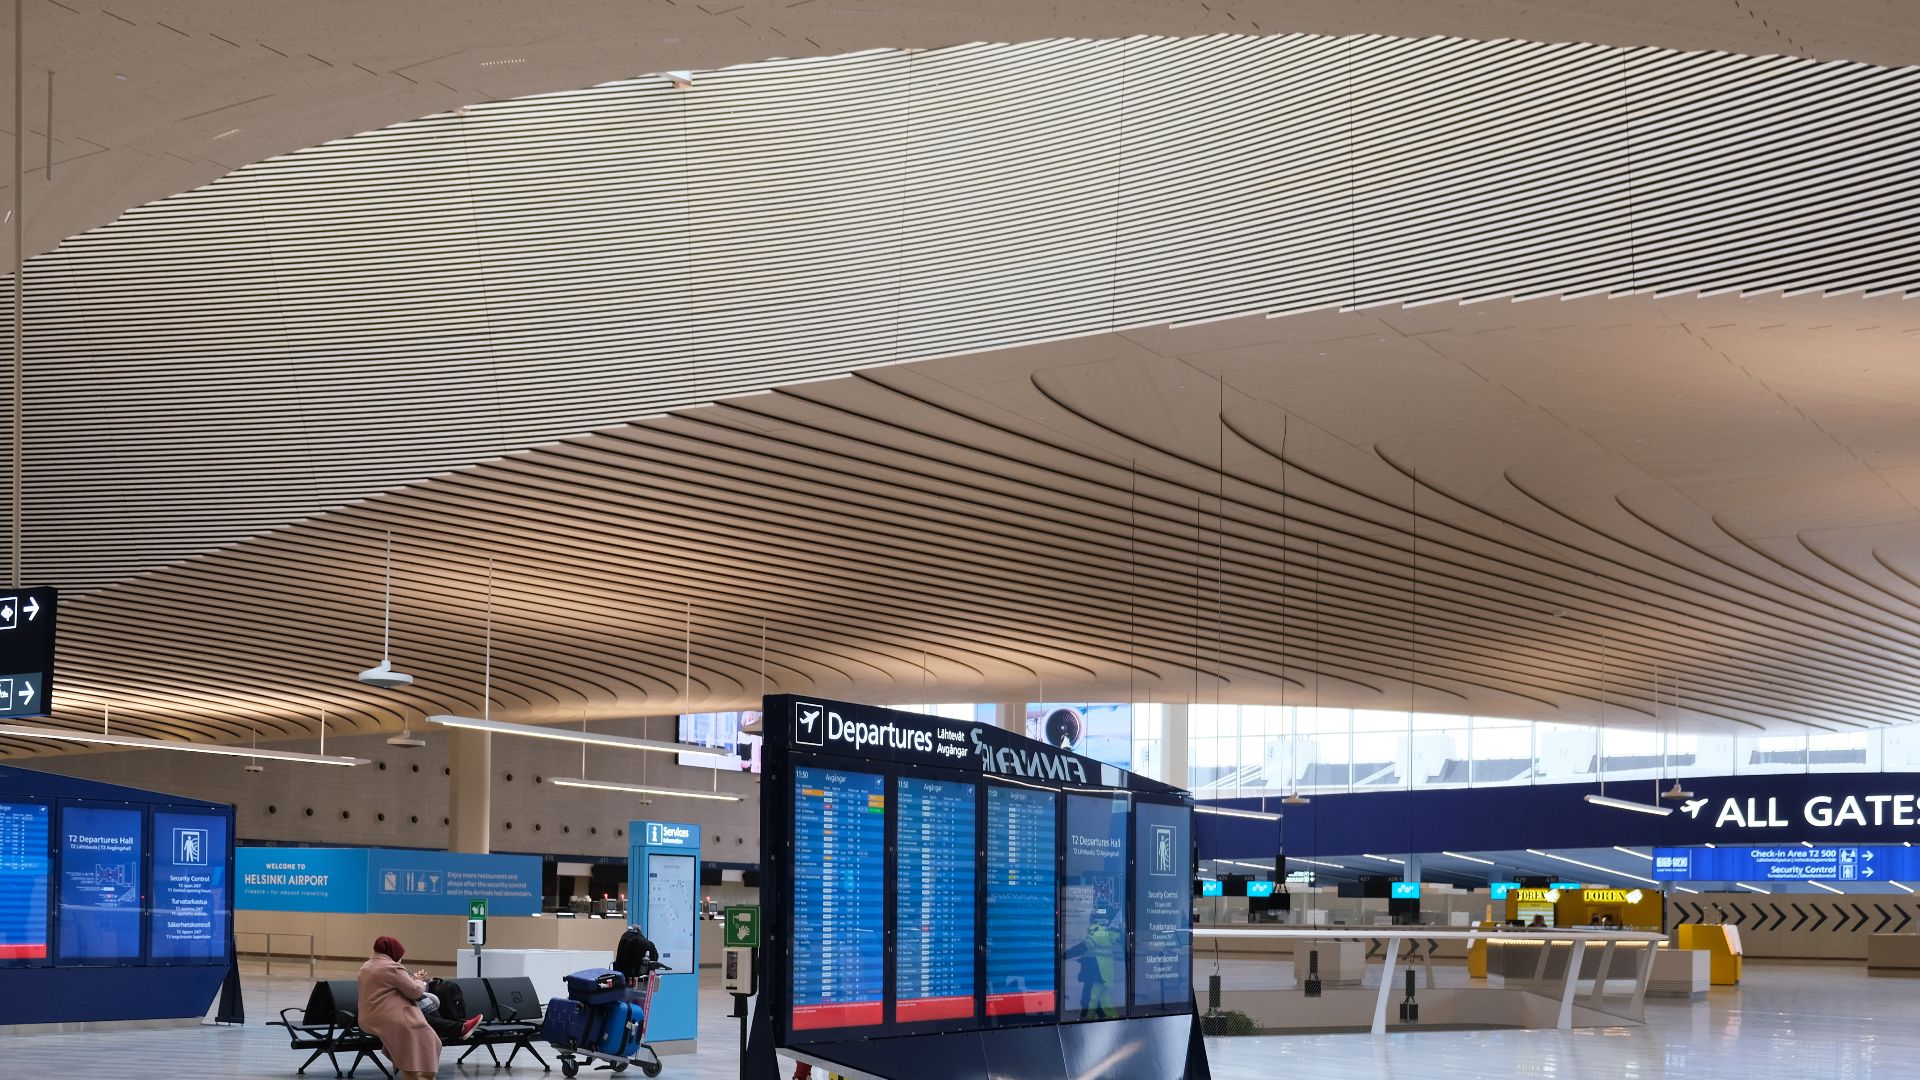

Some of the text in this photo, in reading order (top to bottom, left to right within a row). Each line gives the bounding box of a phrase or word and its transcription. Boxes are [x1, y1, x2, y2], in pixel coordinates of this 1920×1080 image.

[828, 711, 932, 751] Departures
[937, 727, 965, 742] Lähtevät
[937, 743, 967, 757] Avgångar
[1715, 797, 1789, 828] ALL
[663, 826, 689, 838] Services
[69, 834, 78, 842] T2
[80, 835, 118, 845] Departures
[1072, 834, 1121, 848] T2 Departures Hall
[1750, 849, 1837, 859] Check-in Area T2 500
[447, 872, 462, 880] Enjoy
[1770, 866, 1837, 875] Security Control
[244, 873, 329, 886] HELSINKI AIRPORT
[1516, 890, 1548, 901] FOREX
[1584, 890, 1627, 901] FOREX
